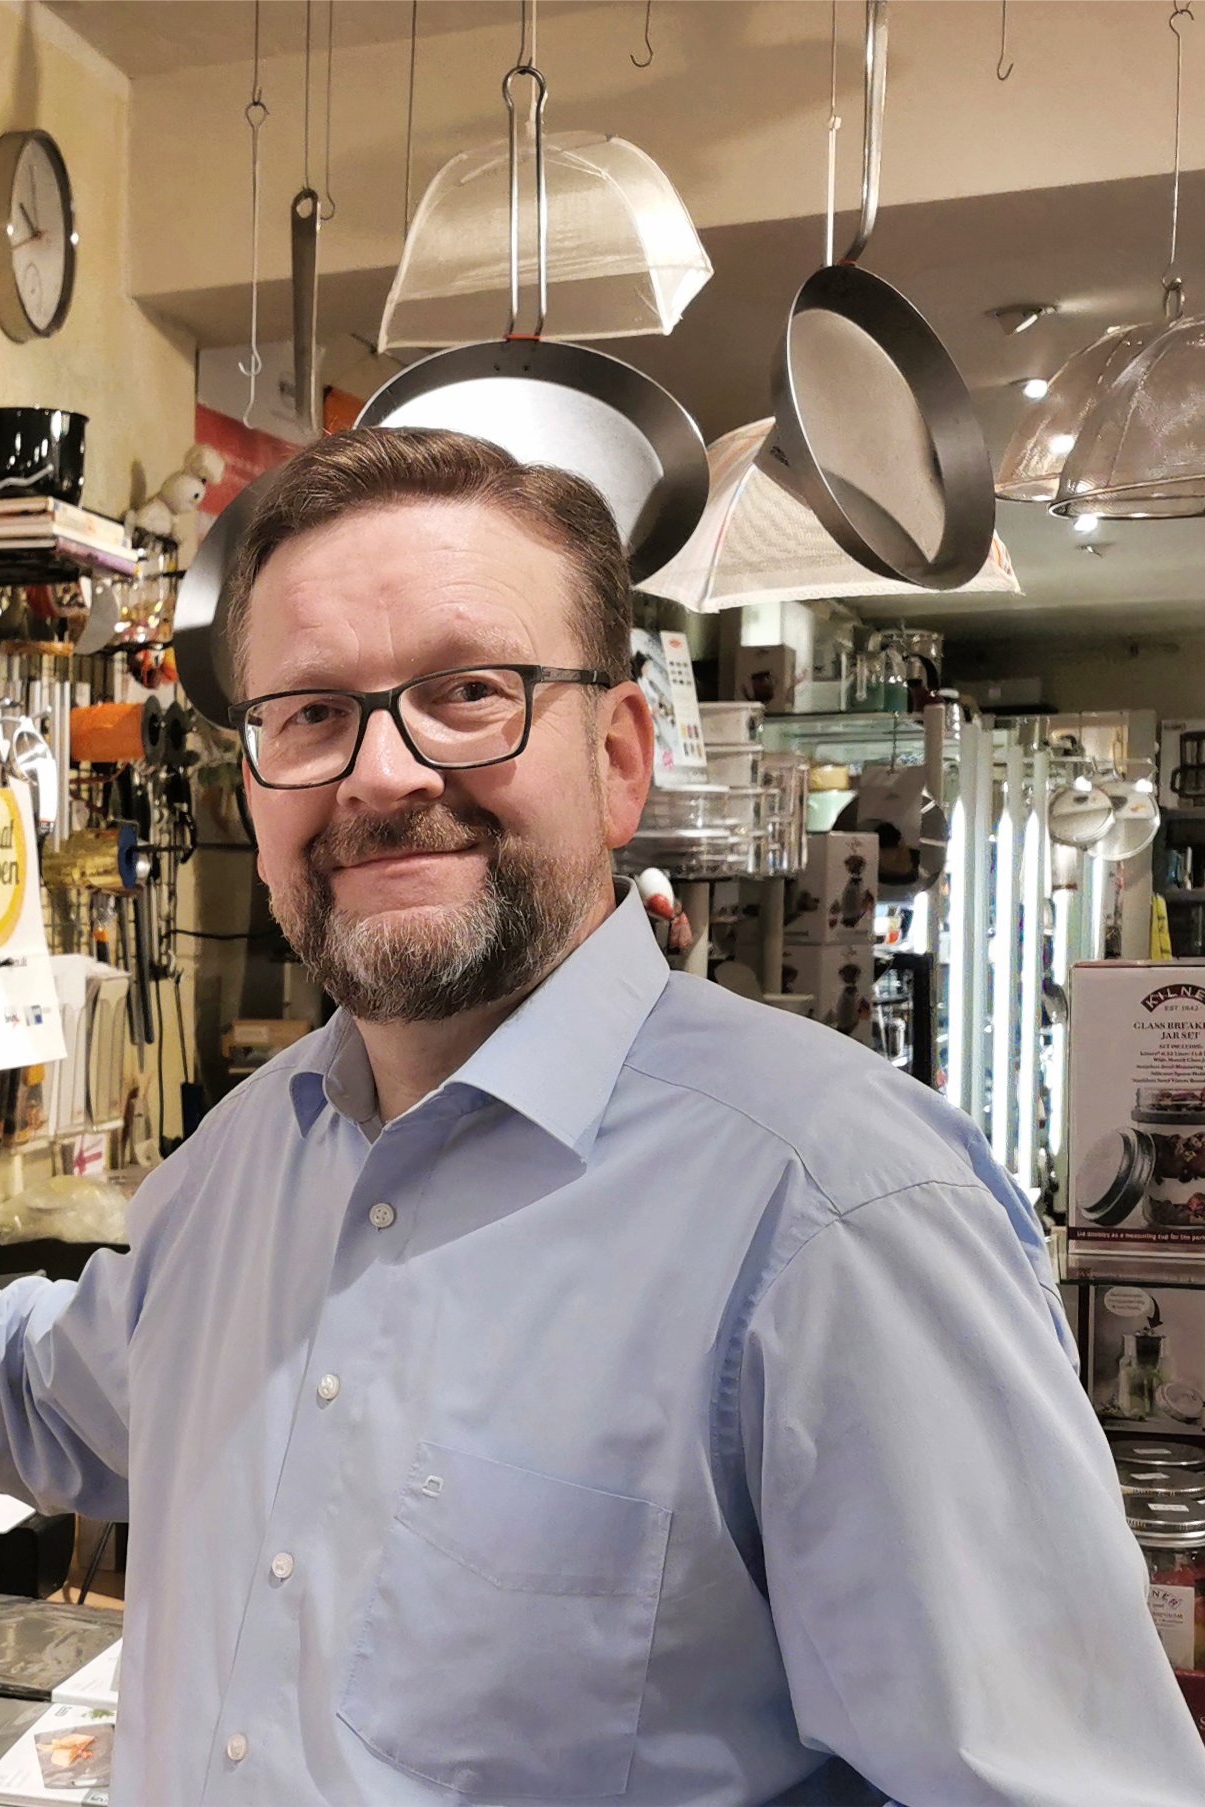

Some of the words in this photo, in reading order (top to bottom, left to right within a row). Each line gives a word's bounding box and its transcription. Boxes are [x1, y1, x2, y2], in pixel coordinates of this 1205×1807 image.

[1133, 1022, 1165, 1030] GLASS
[1161, 1031, 1179, 1040] JAR
[1181, 1031, 1200, 1040] SET
